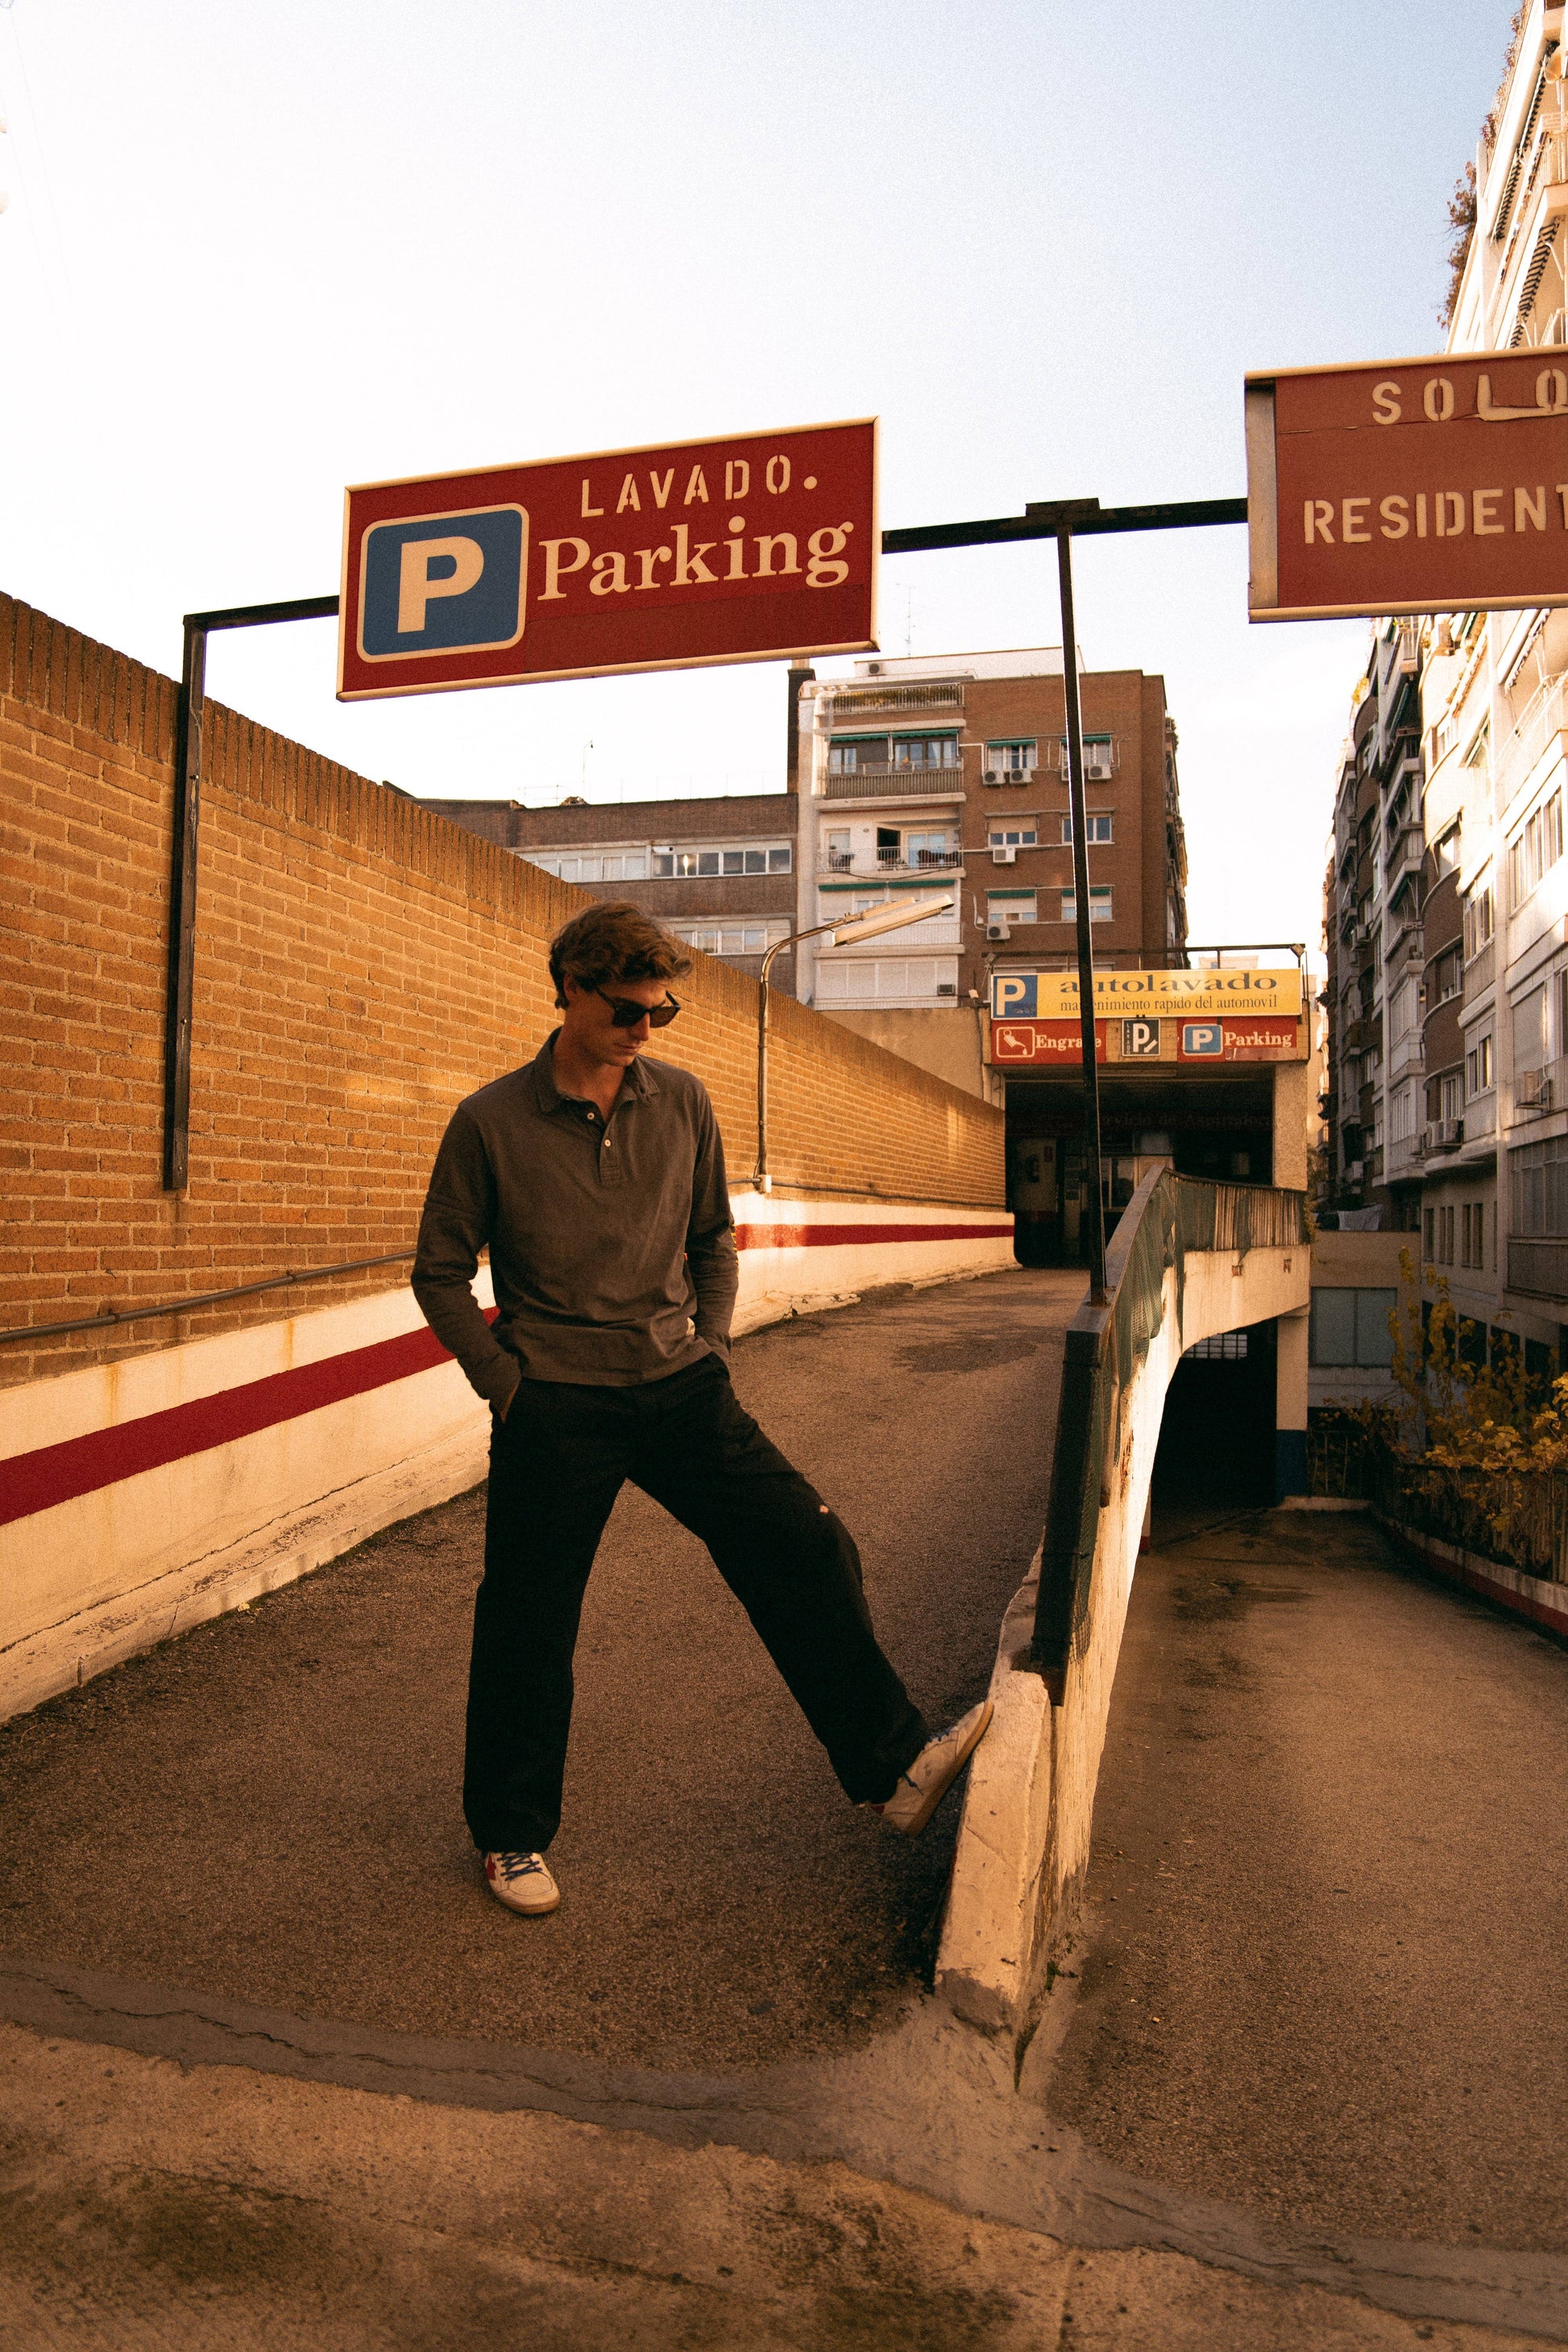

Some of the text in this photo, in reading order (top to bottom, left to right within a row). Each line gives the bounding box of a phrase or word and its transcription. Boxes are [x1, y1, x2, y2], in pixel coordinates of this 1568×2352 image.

[1371, 368, 1568, 425] SOLO
[580, 454, 817, 517] LAVADO.
[537, 516, 854, 601] Parking
[396, 536, 484, 633] P
[996, 977, 1027, 1016] P
[1060, 994, 1277, 1014] manimiento rapido del automovil
[1035, 1035, 1101, 1051] Engrae
[1133, 1023, 1150, 1052] P
[1193, 1029, 1213, 1051] P
[1224, 1031, 1292, 1048] Parking
